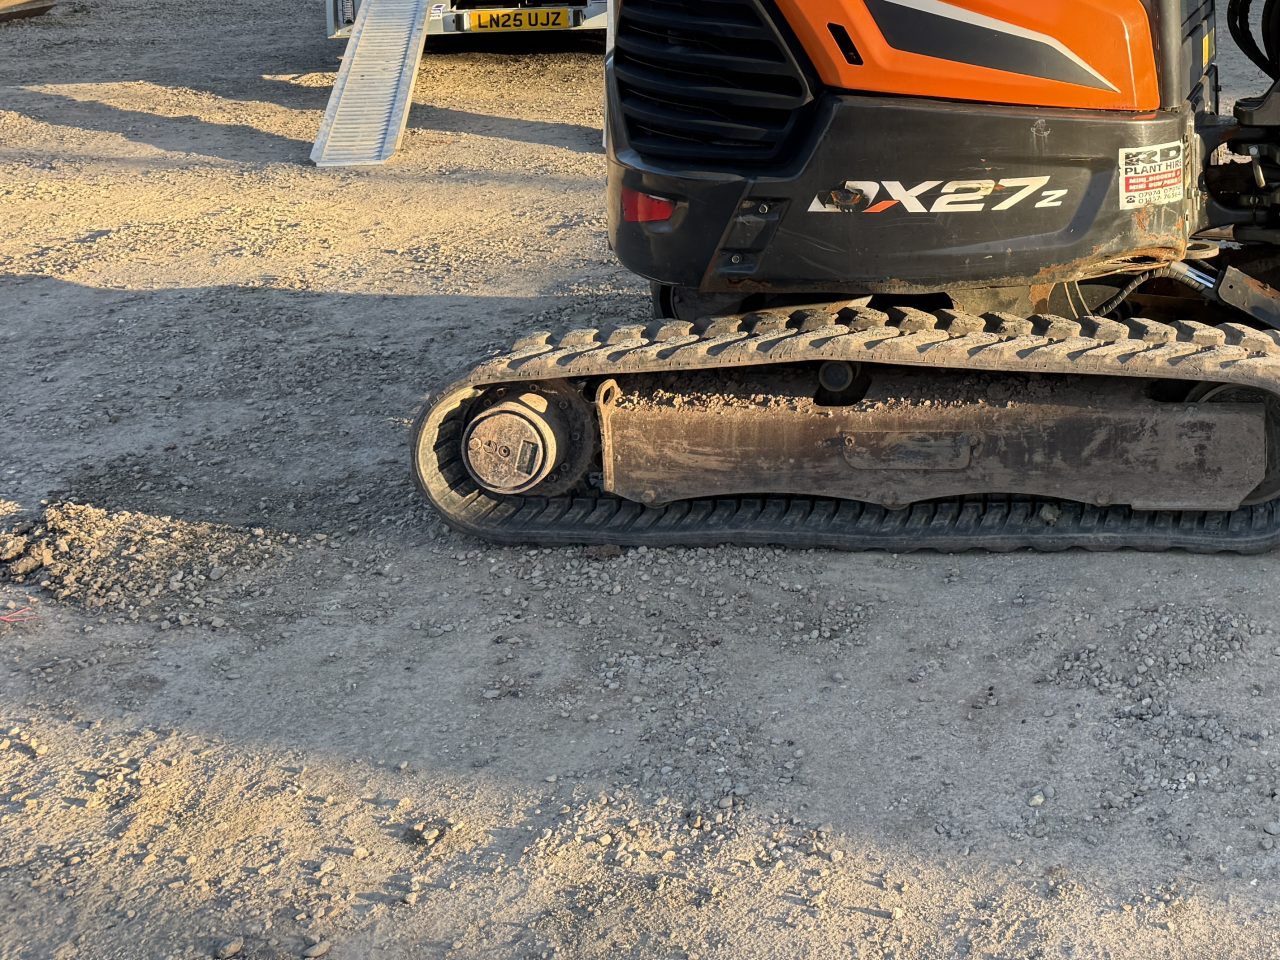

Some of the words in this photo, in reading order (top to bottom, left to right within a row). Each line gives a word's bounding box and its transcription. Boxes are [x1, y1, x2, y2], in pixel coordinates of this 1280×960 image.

[478, 13, 523, 29] LN25
[527, 11, 561, 27] UJZ
[1125, 163, 1163, 175] PLANT
